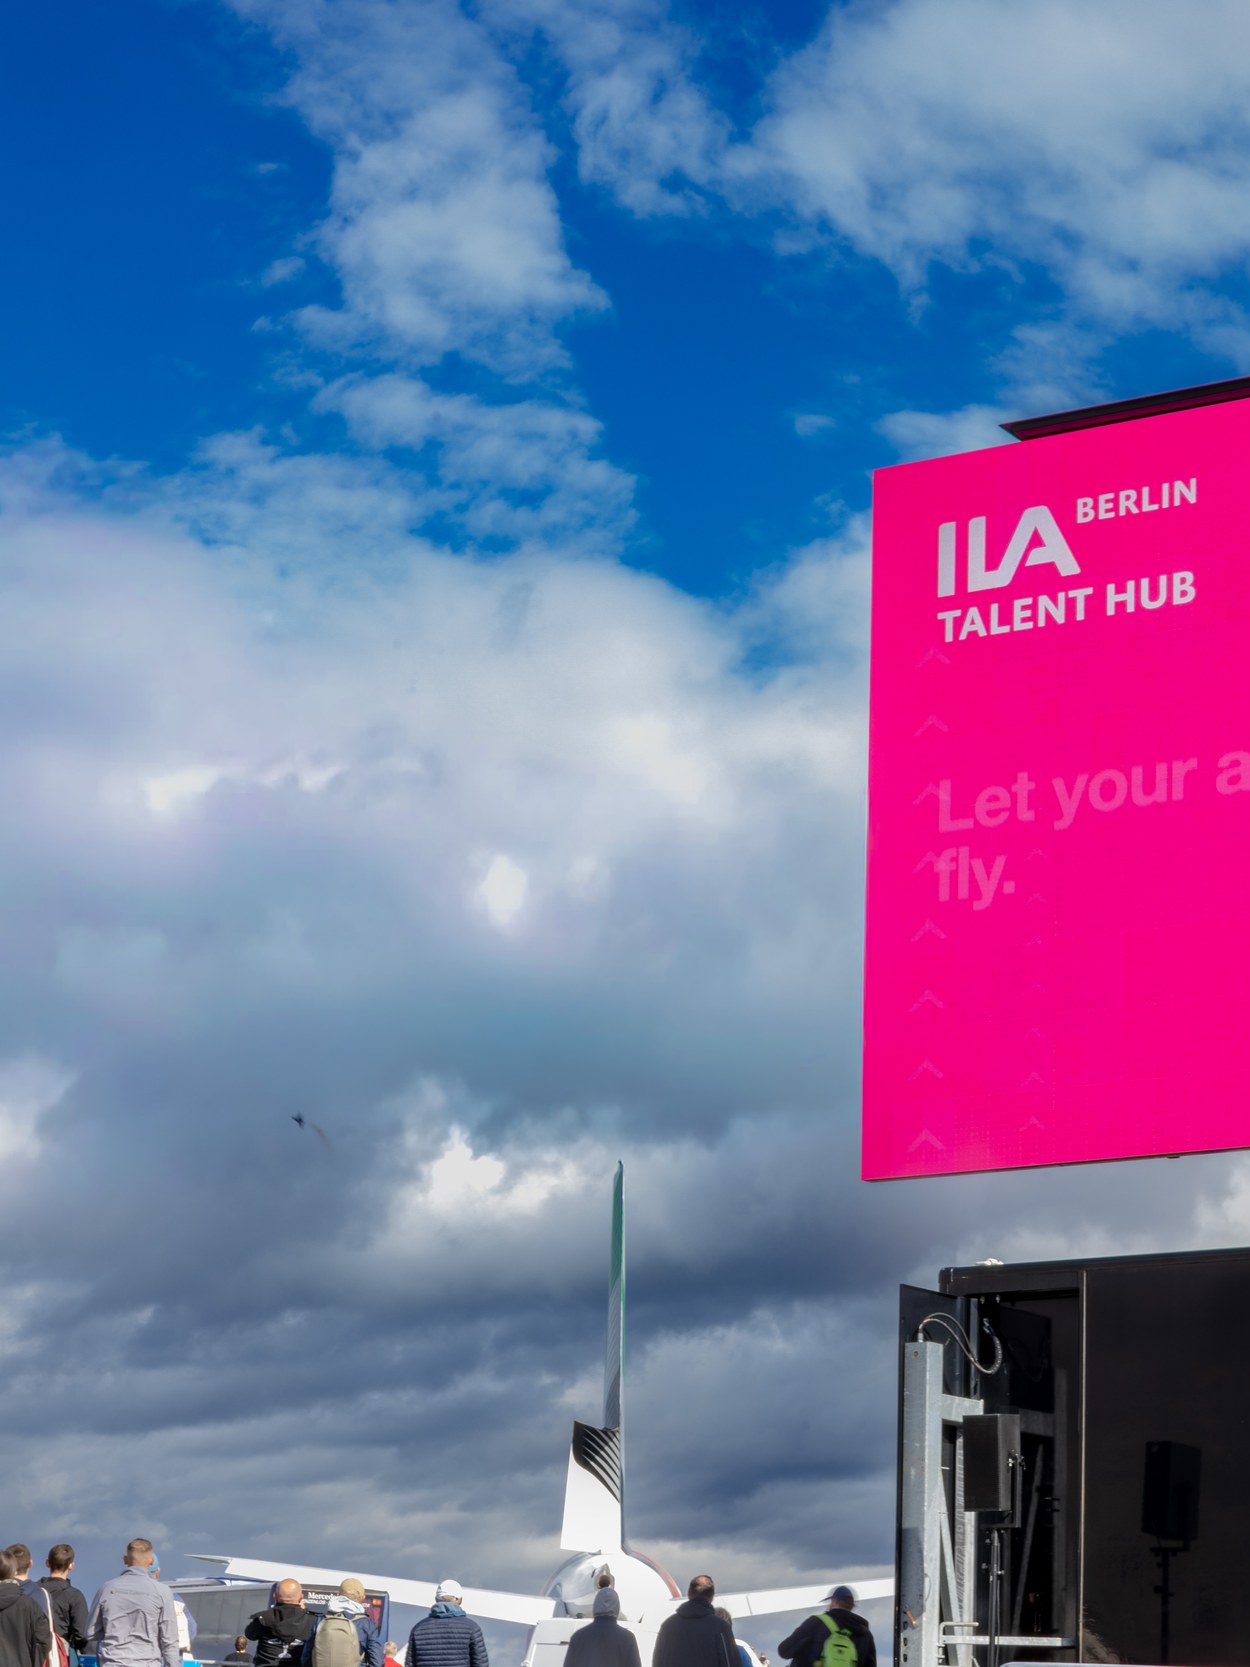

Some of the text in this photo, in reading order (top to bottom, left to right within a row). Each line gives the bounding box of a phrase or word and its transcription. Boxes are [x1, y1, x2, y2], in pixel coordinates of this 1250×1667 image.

[936, 477, 1198, 599] ILA BERLIN
[936, 570, 1197, 643] TALENT HUB
[938, 771, 1036, 833] Let
[1051, 756, 1198, 831] your
[933, 845, 1016, 912] fly.
